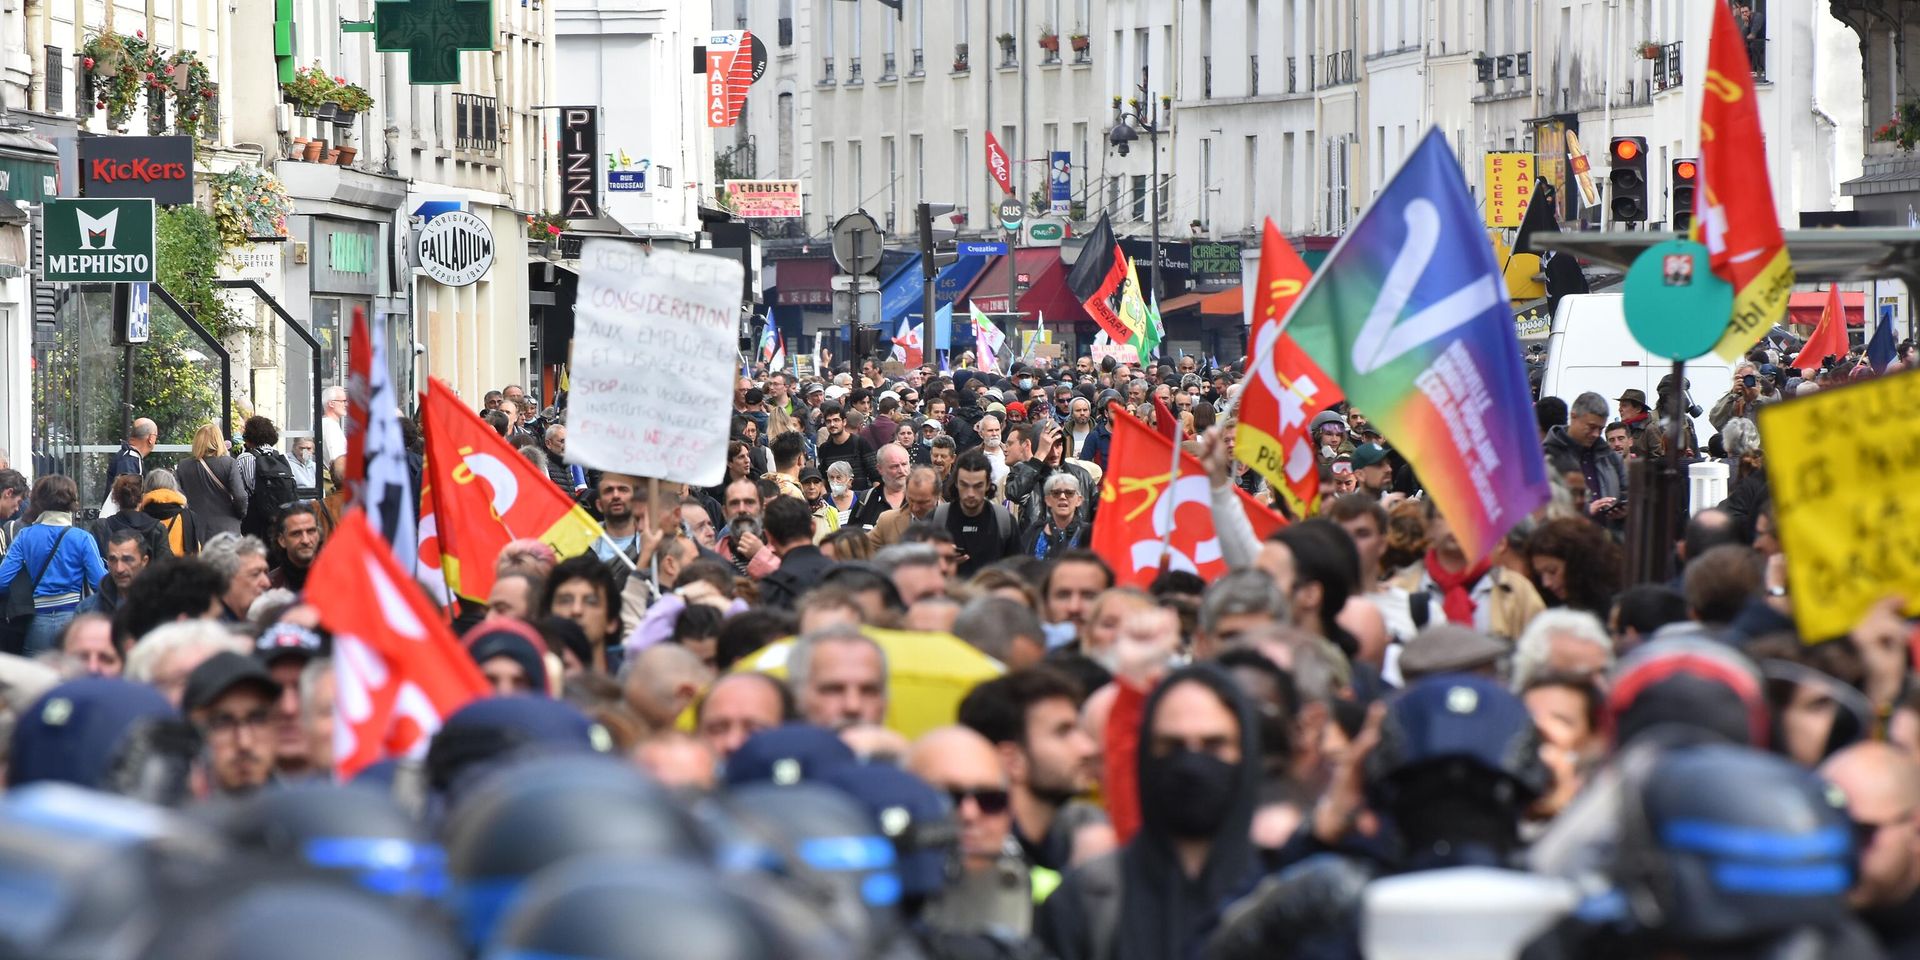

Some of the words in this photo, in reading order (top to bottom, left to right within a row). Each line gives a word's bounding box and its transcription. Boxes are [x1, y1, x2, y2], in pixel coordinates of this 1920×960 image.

[752, 60, 766, 79] PAIN
[711, 55, 724, 124] TABAC
[567, 109, 594, 217] PIZZA
[609, 181, 644, 189] TROUSSEAU
[620, 174, 634, 182] RUE
[1002, 205, 1022, 217] BUS
[427, 214, 485, 234] L'ORIGINALE
[421, 226, 491, 272] PALLADIUM
[967, 245, 998, 253] Crozatier
[1192, 243, 1239, 258] CRÊPE
[49, 253, 149, 274] MEPHISTO
[430, 265, 461, 283] DEPUIS
[466, 263, 484, 275] 1947
[592, 287, 731, 329] CONSIDERATION
[1092, 297, 1128, 337] GUEVARA
[589, 321, 625, 341] AUX
[591, 348, 611, 368] ET
[578, 378, 619, 395] STOP
